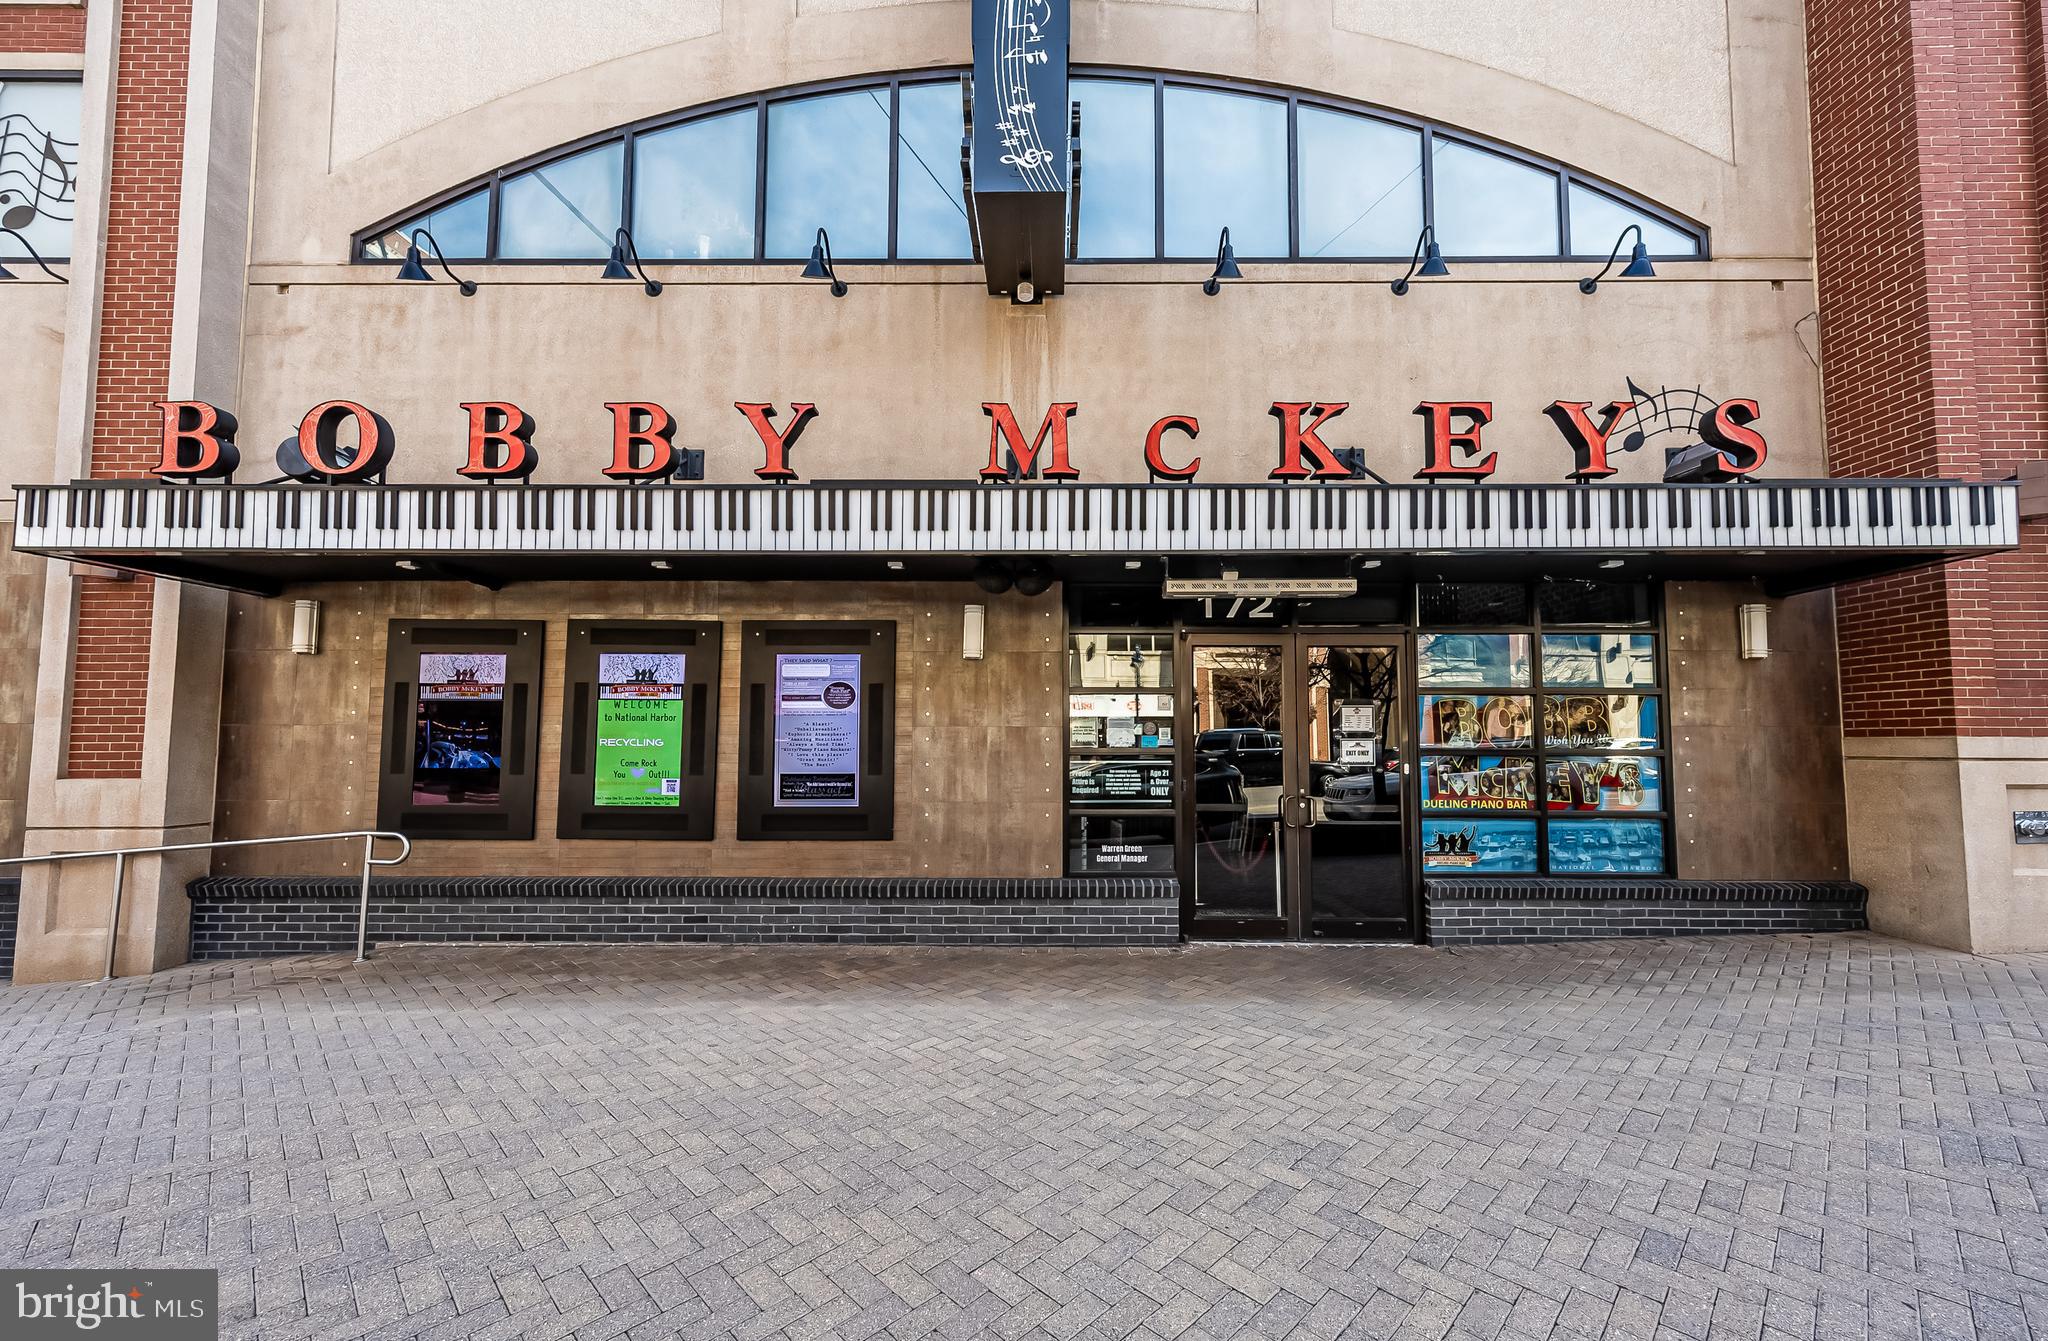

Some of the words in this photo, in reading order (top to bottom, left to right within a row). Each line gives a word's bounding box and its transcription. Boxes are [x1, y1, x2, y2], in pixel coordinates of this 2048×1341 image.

[150, 399, 818, 478] BOBBY
[1198, 597, 1274, 618] 172
[613, 700, 668, 709] WELCOME
[604, 713, 613, 722] to
[615, 713, 648, 722] National
[650, 713, 677, 722] Harbor
[599, 738, 664, 747] RECYCLING
[1544, 734, 1568, 745] Wish
[1571, 734, 1594, 748] You
[620, 759, 639, 767] Come
[641, 759, 657, 767] Rock
[613, 770, 626, 778] You
[648, 770, 670, 778] Out!!!
[1072, 786, 1099, 794] Required
[1150, 787, 1169, 796] ONLY
[1423, 799, 1469, 809] DUELING
[1471, 799, 1505, 809] PIANO
[1506, 800, 1528, 810] BAR
[1096, 854, 1120, 862] General
[1121, 854, 1148, 863] Manager
